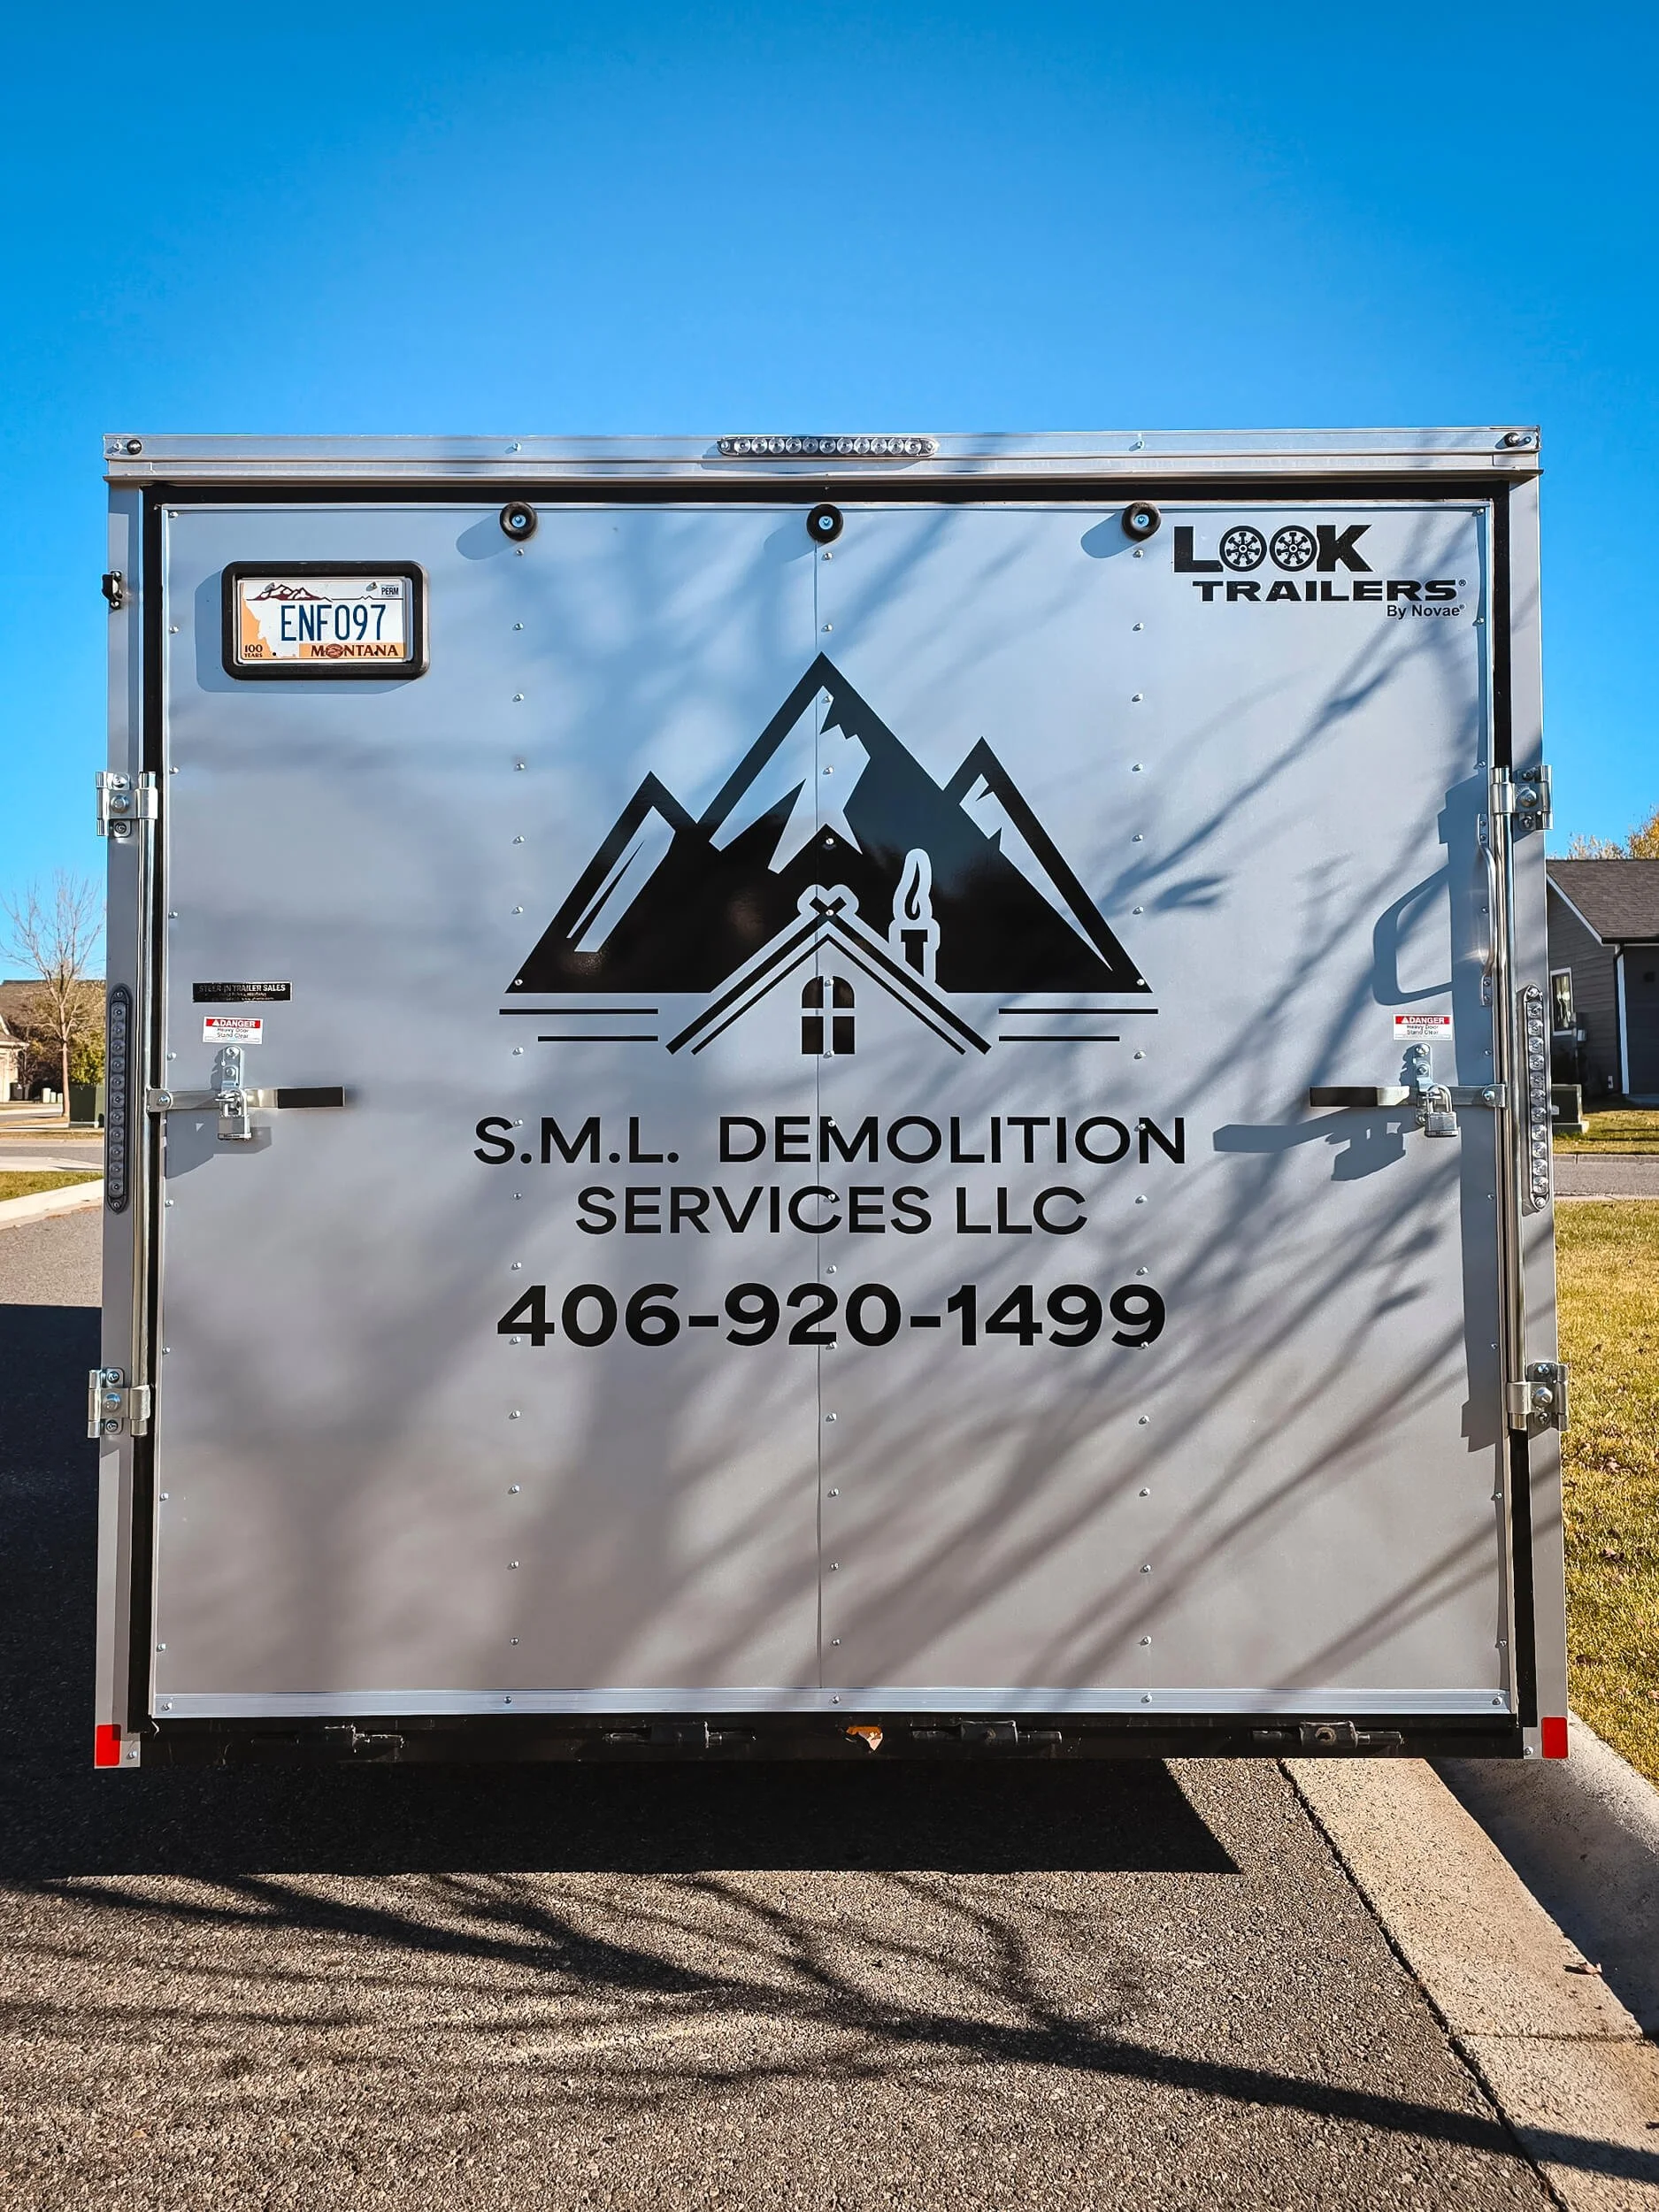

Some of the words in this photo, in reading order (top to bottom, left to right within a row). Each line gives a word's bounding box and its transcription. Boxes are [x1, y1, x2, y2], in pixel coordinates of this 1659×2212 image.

[1174, 525, 1372, 572] LOOK
[381, 587, 399, 595] PERM
[1386, 605, 1406, 619] By
[311, 643, 398, 658] MONTANA
[474, 1116, 680, 1165] S.M.L.
[719, 1116, 1186, 1165] DEMOLITION
[576, 1186, 932, 1234] SERVICES
[956, 1187, 1088, 1234] LLC
[497, 1283, 1165, 1347] 406-920-1499
